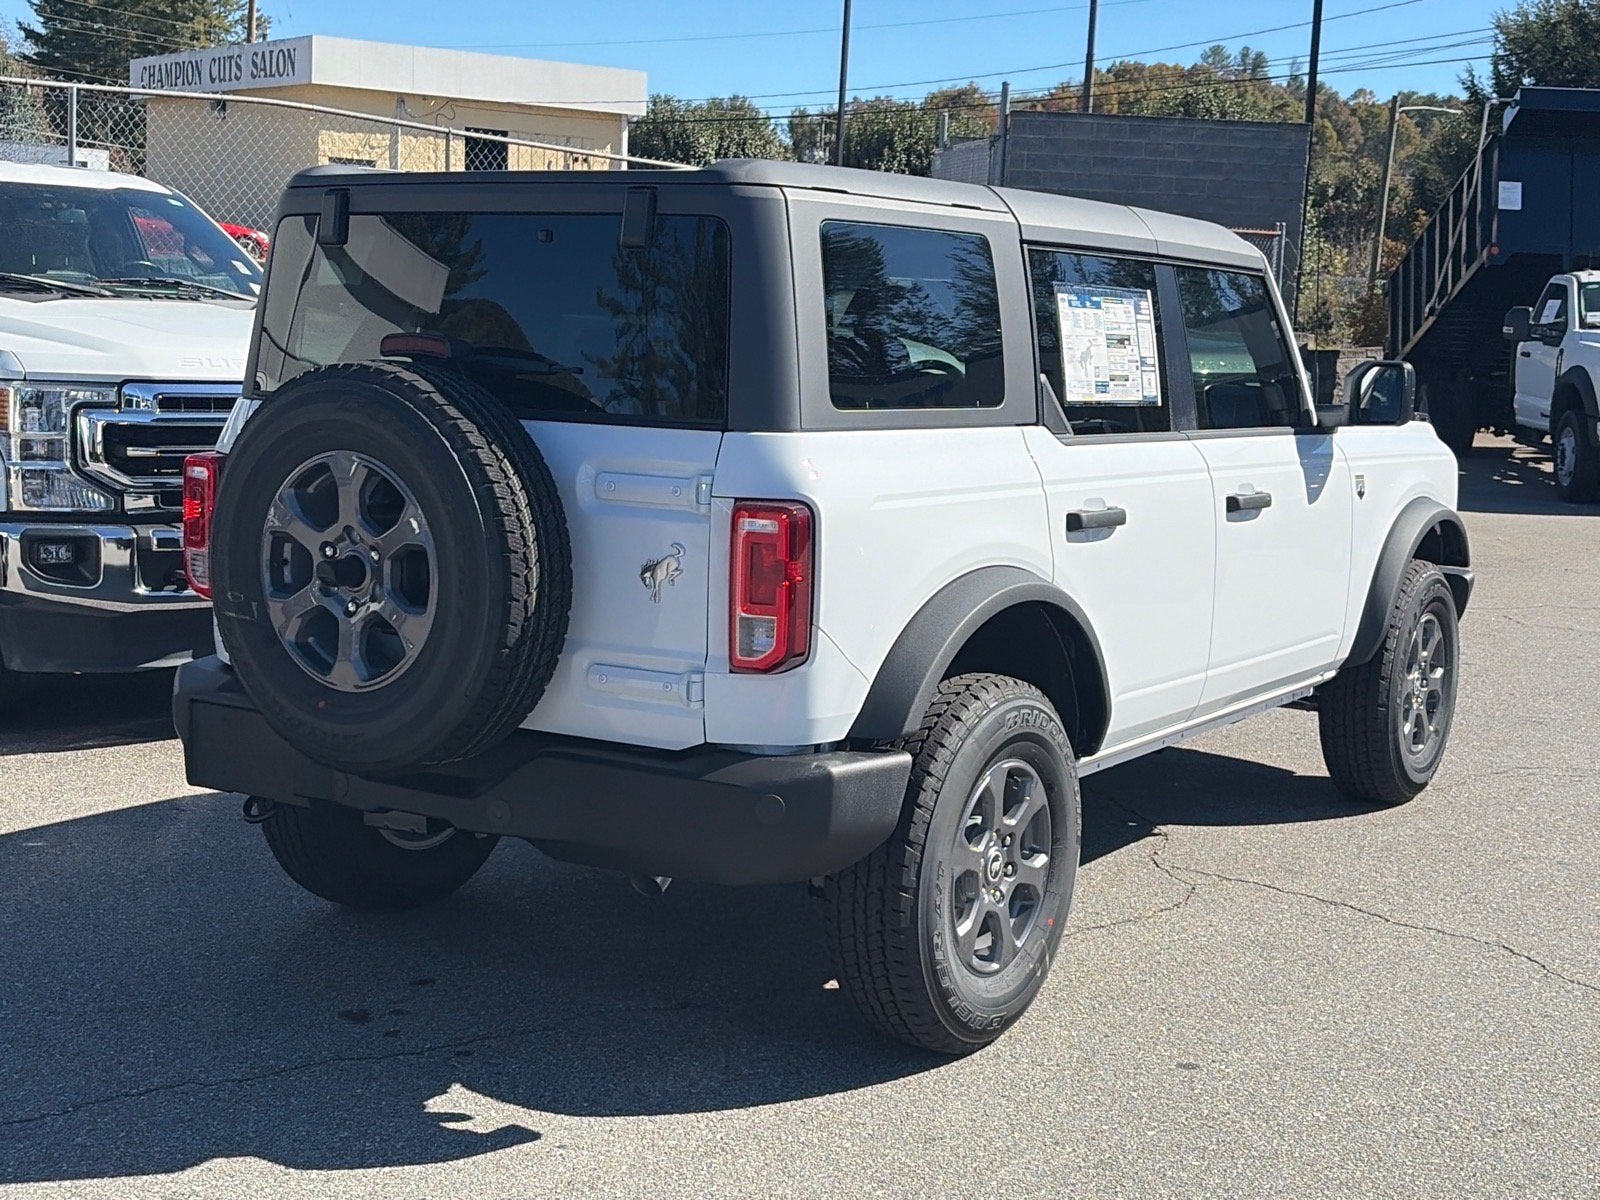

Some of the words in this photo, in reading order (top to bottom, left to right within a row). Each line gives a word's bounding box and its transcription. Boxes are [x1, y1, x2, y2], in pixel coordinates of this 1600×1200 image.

[140, 59, 202, 89] CHAMPION
[209, 54, 243, 84] CUTS
[250, 47, 296, 80] SALON
[932, 930, 1008, 1031] DUELER
